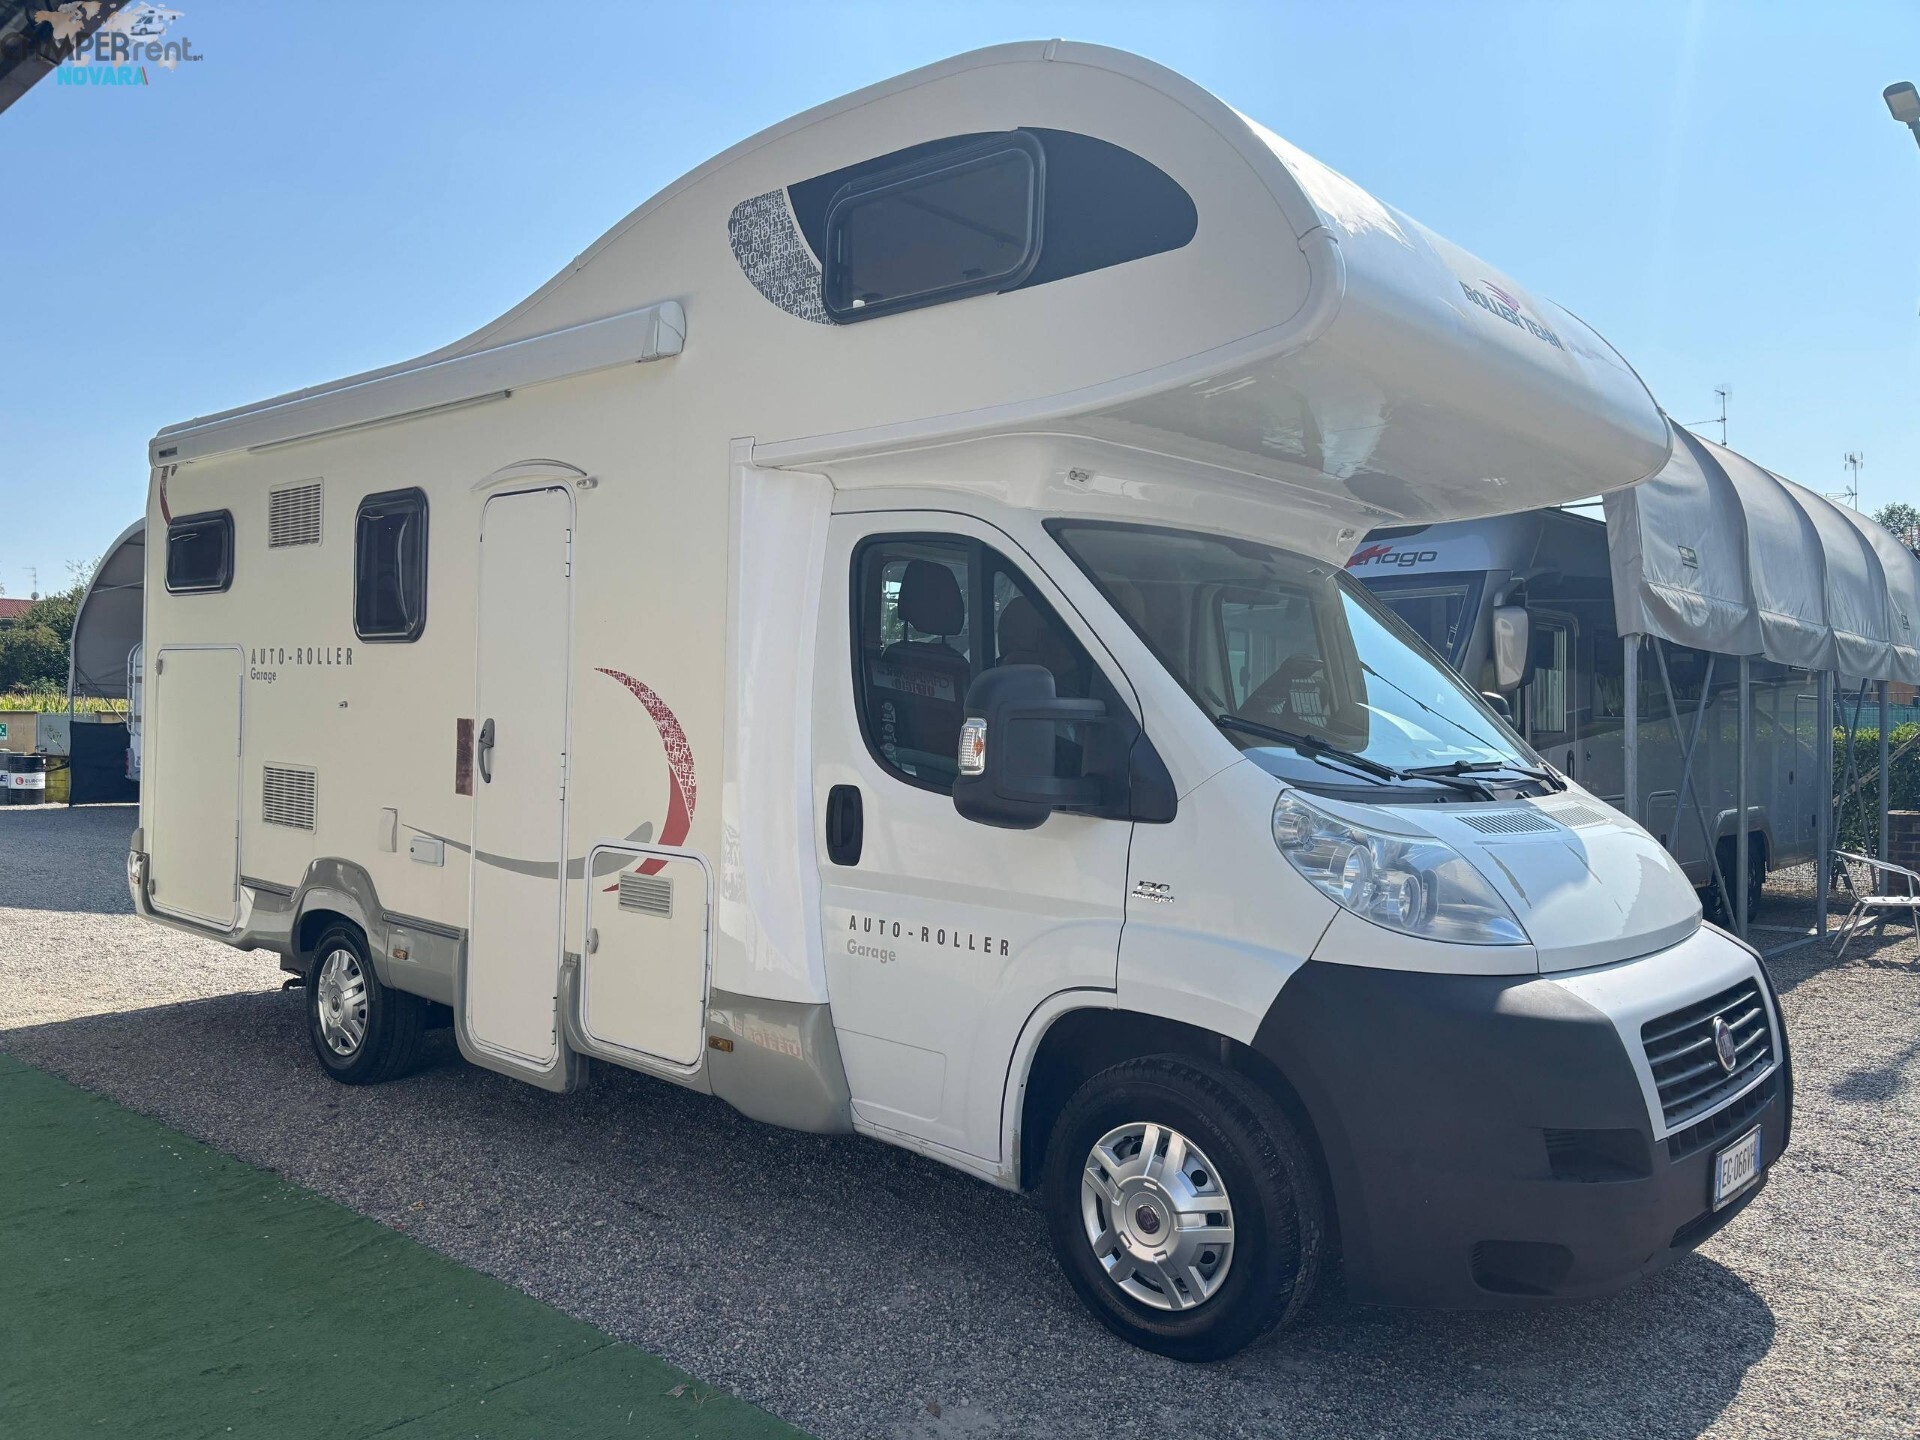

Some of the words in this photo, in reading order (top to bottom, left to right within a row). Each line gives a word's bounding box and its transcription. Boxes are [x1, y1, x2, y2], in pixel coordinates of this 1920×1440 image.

[1459, 280, 1526, 330] ROLLER
[1519, 314, 1565, 351] TEAM
[251, 647, 353, 665] AUTO-ROLLER
[250, 667, 277, 684] Garage
[849, 915, 1009, 956] AUTO-ROLLER
[846, 938, 897, 964] Garage
